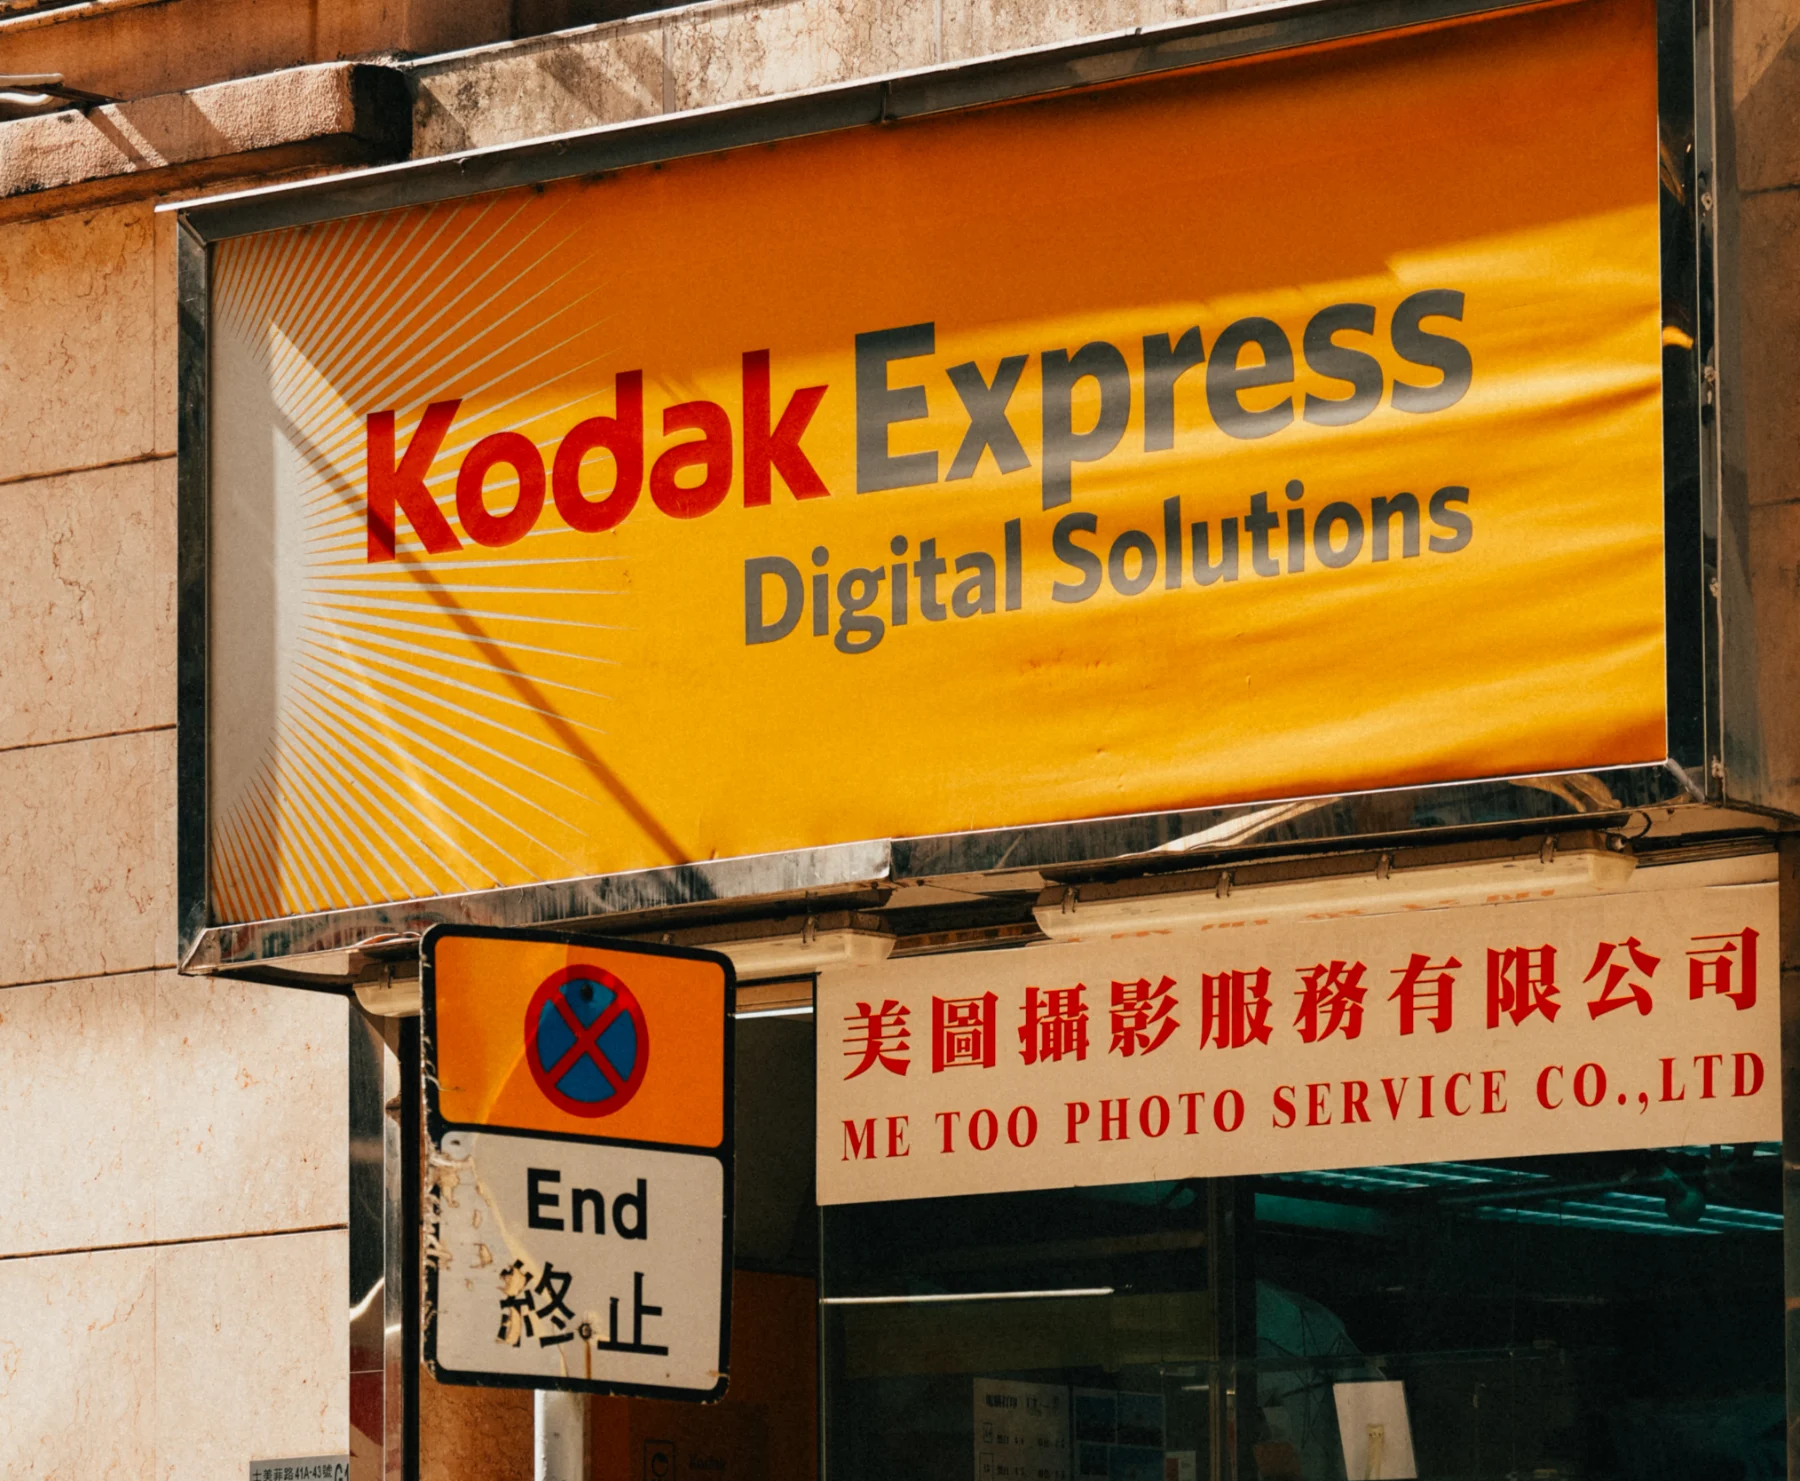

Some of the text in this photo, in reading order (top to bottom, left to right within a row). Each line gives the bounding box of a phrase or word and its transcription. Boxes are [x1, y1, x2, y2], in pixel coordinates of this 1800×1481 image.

[366, 288, 1474, 563] Kodak Express
[744, 478, 1474, 655] Digital Solutions
[841, 926, 1760, 1081] 美圖攝影服務有限公司
[841, 1116, 911, 1161] ME
[937, 1106, 1039, 1154] TOO
[1064, 1088, 1246, 1145] PHOTO
[1271, 1069, 1507, 1130] SERVICE
[527, 1167, 648, 1240] End
[496, 1259, 669, 1356] 終止
